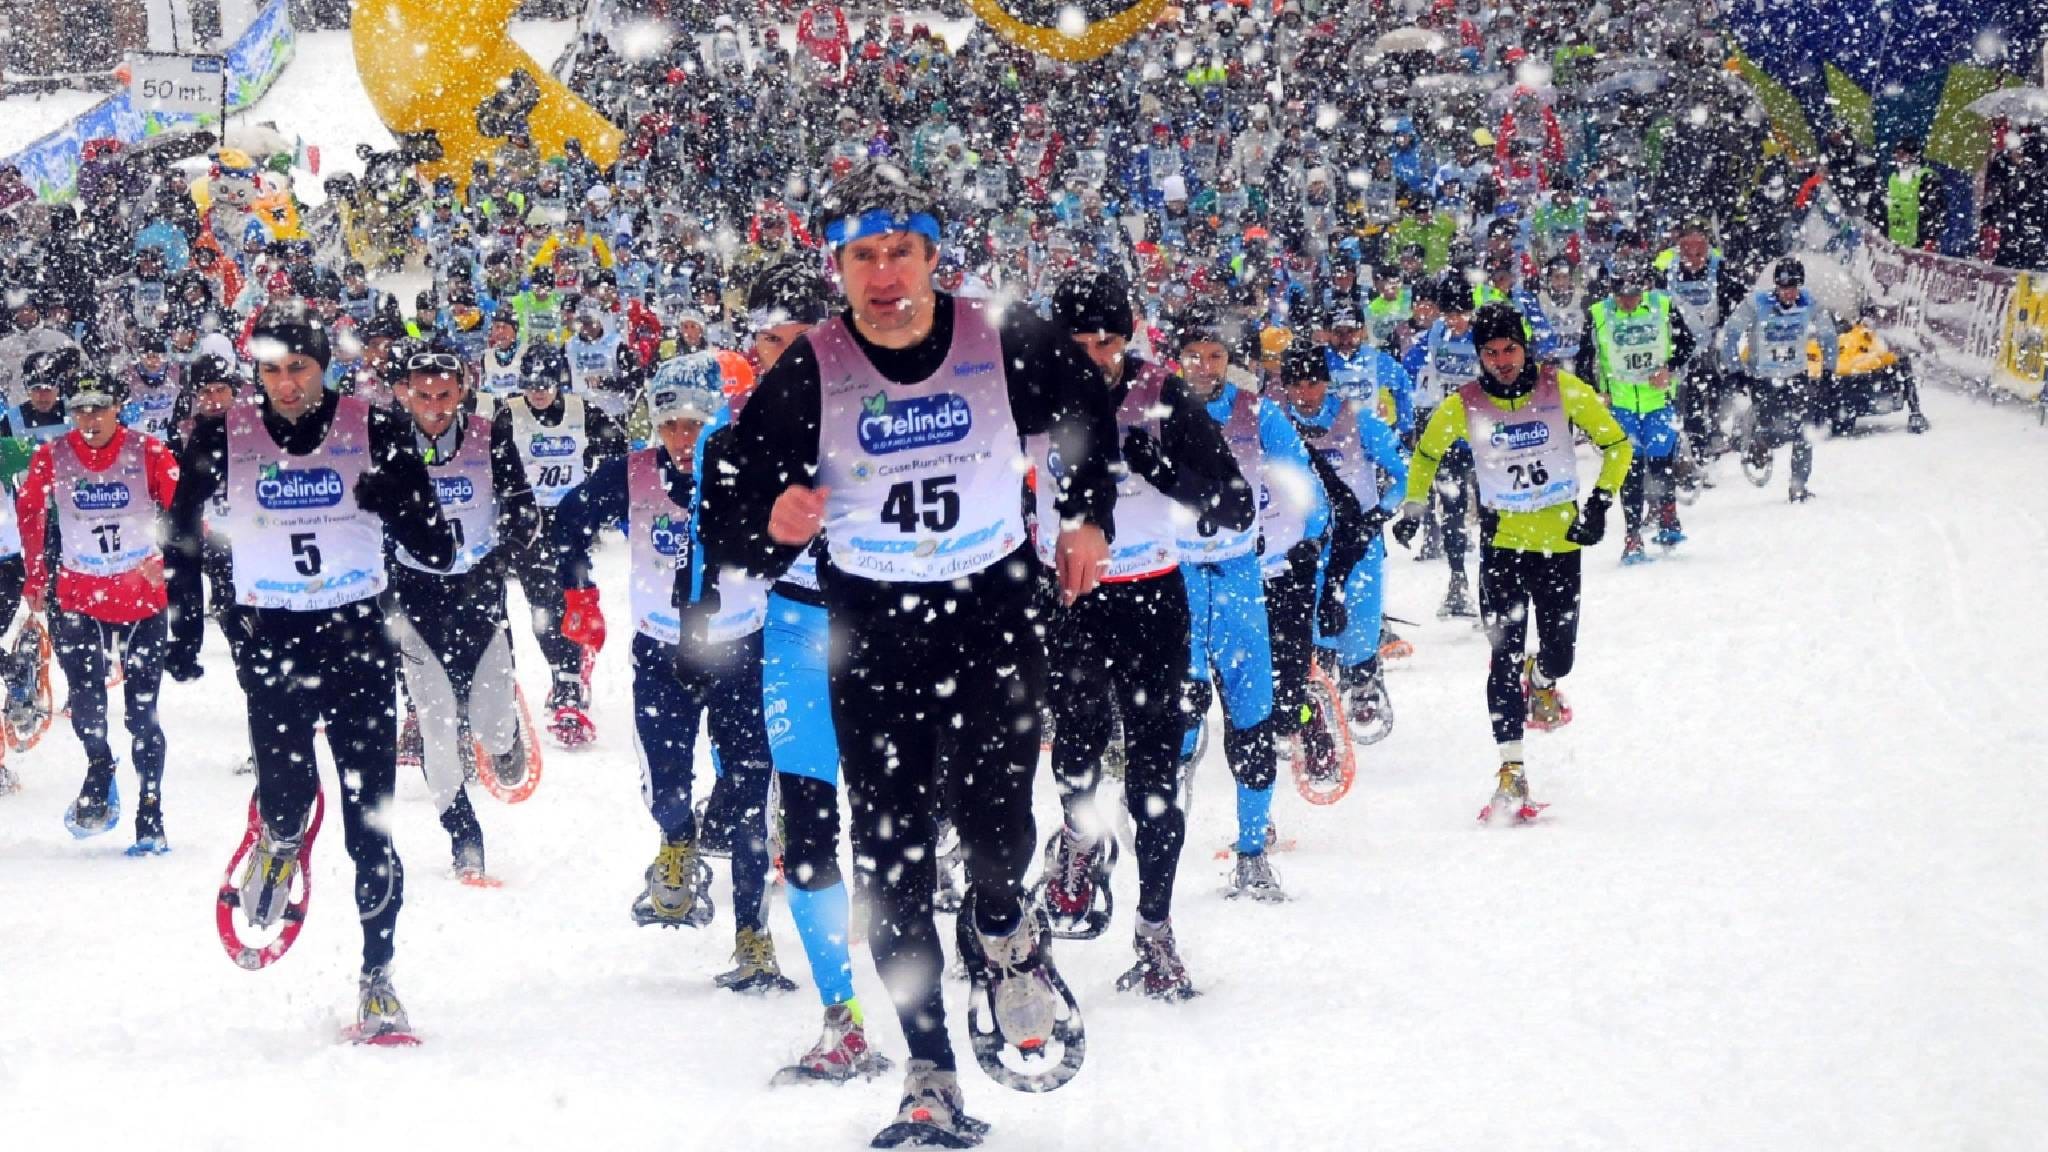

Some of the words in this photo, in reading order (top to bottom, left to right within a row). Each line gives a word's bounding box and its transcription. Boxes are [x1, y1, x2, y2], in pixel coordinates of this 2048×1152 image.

[143, 80, 173, 98] 50
[179, 84, 212, 101] mt.
[862, 402, 969, 441] Melinda
[1493, 422, 1547, 447] Melinda
[258, 475, 342, 498] Melinda
[1507, 460, 1549, 490] 26
[75, 488, 129, 503] Melinda
[436, 480, 472, 498] linda
[881, 474, 960, 533] 45
[91, 524, 120, 553] 17
[290, 532, 322, 577] 5
[858, 556, 894, 573] 2014
